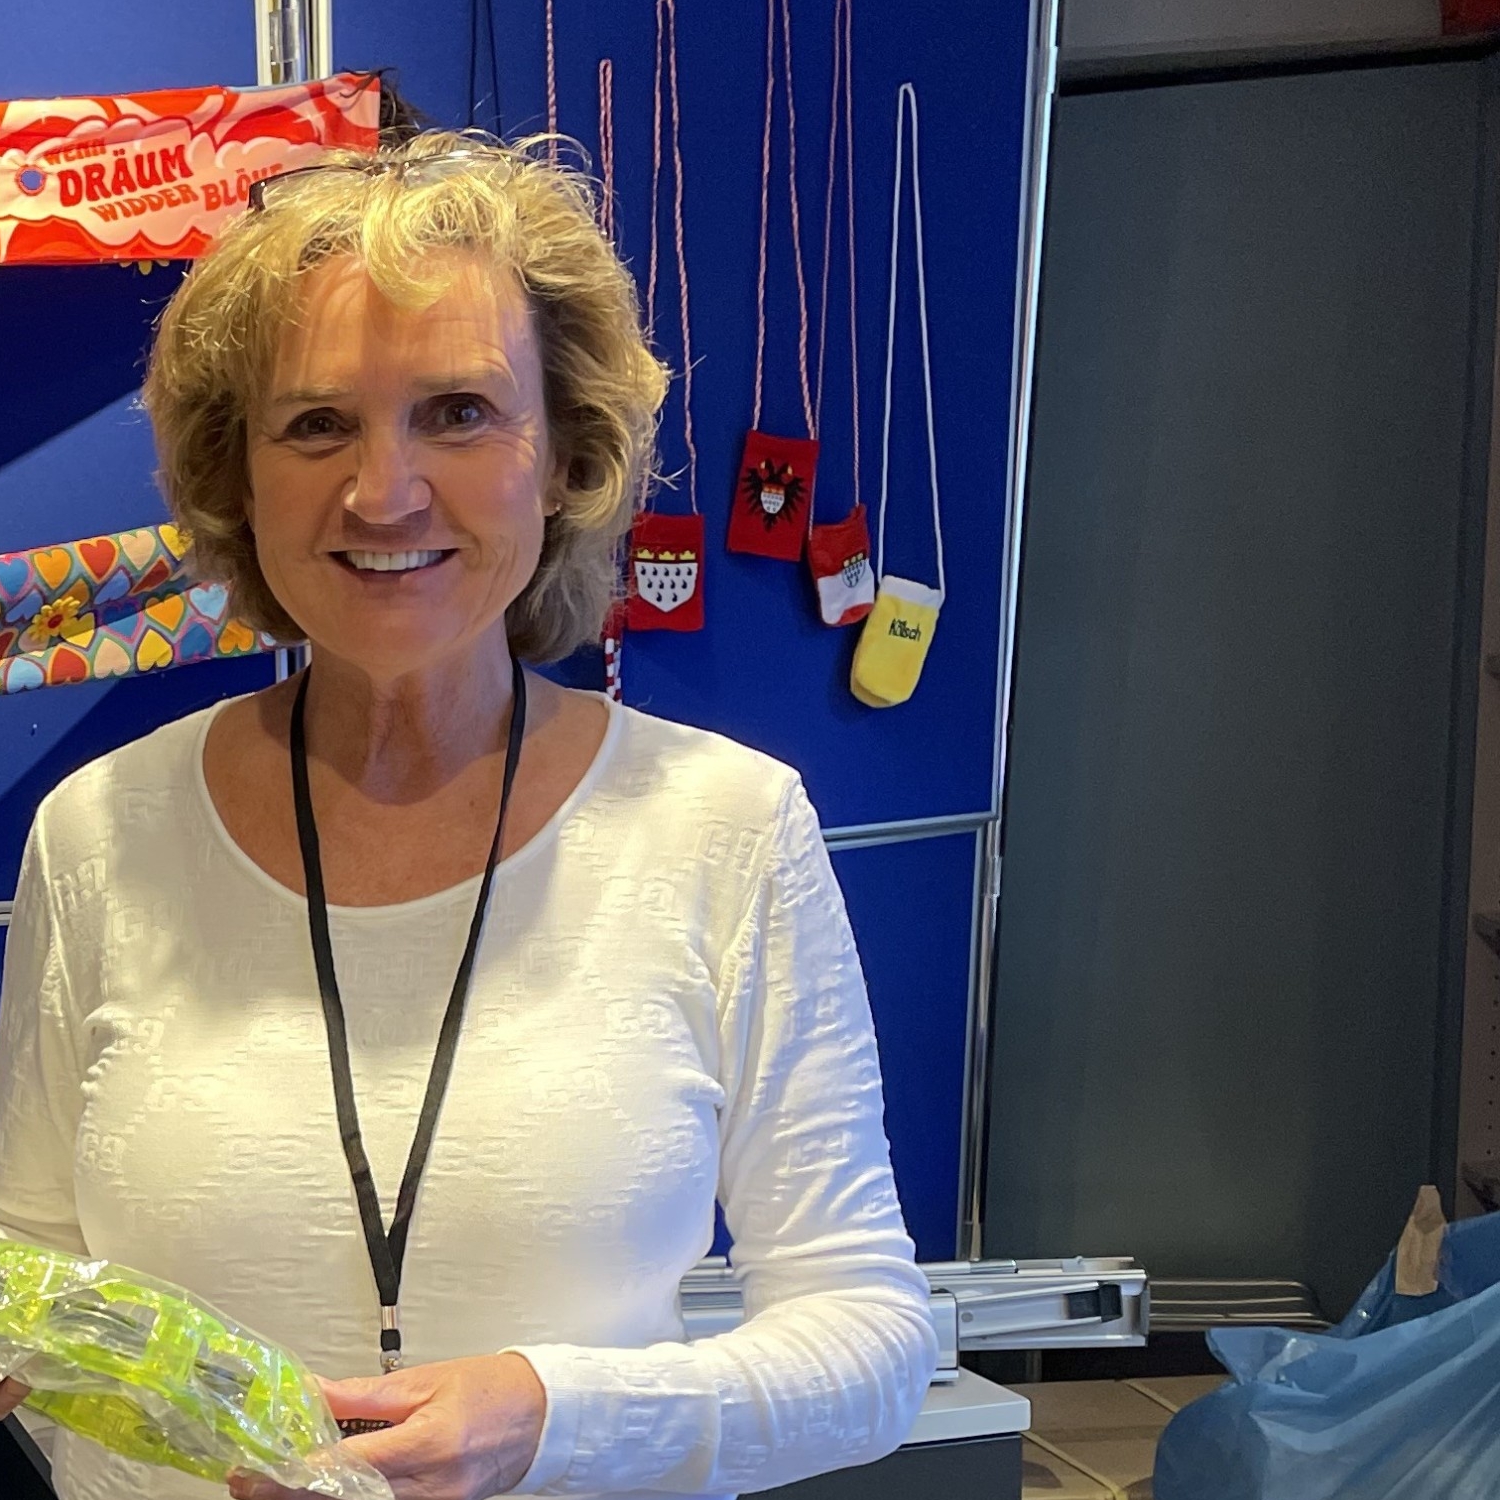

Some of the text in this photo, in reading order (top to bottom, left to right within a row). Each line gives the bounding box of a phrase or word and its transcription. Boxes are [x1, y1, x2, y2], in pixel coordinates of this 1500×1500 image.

[44, 139, 107, 166] WENN
[57, 145, 194, 207] DRÄUM
[89, 182, 199, 223] WIDDER
